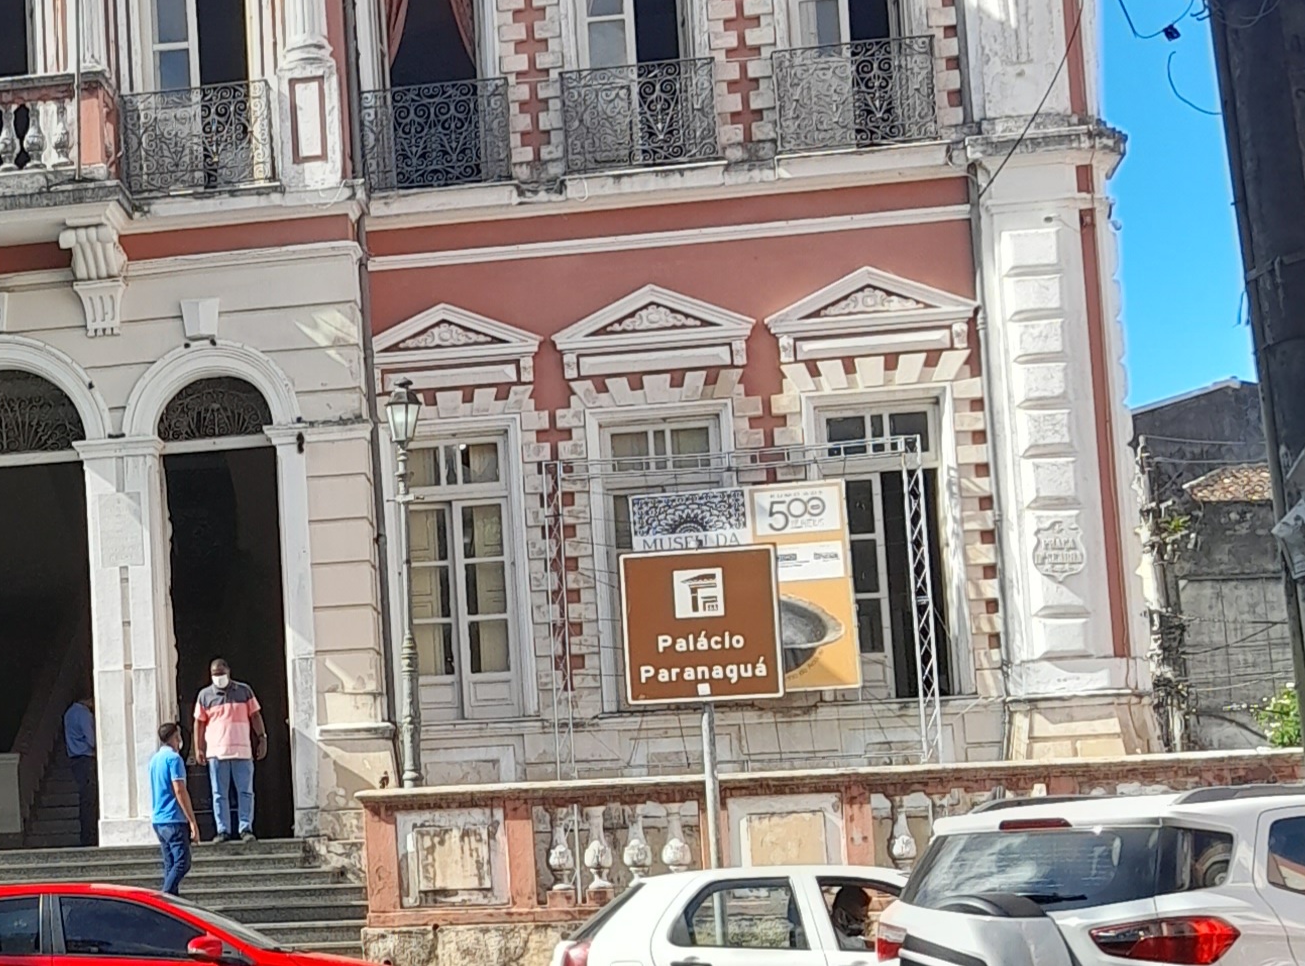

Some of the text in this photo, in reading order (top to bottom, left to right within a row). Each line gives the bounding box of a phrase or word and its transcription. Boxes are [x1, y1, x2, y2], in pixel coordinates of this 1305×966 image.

[768, 496, 826, 532] 500
[716, 532, 740, 547] DA
[657, 631, 745, 653] Palácio
[639, 656, 768, 684] Paranaguá
